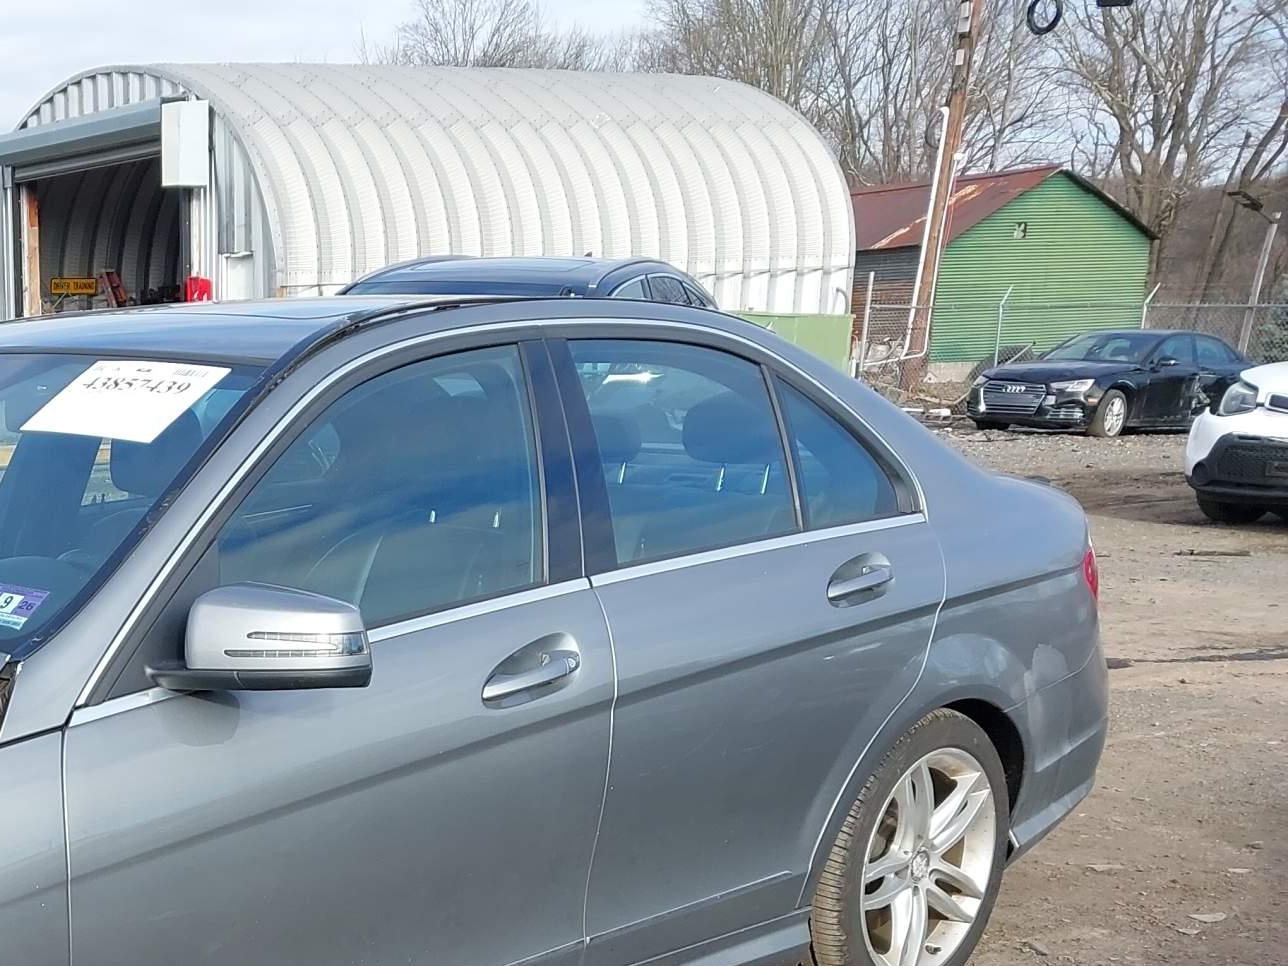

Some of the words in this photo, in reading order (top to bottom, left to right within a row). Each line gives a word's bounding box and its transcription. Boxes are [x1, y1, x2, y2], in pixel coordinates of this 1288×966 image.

[83, 376, 192, 394] 43857439
[0, 595, 14, 609] 9
[19, 600, 37, 611] 26
